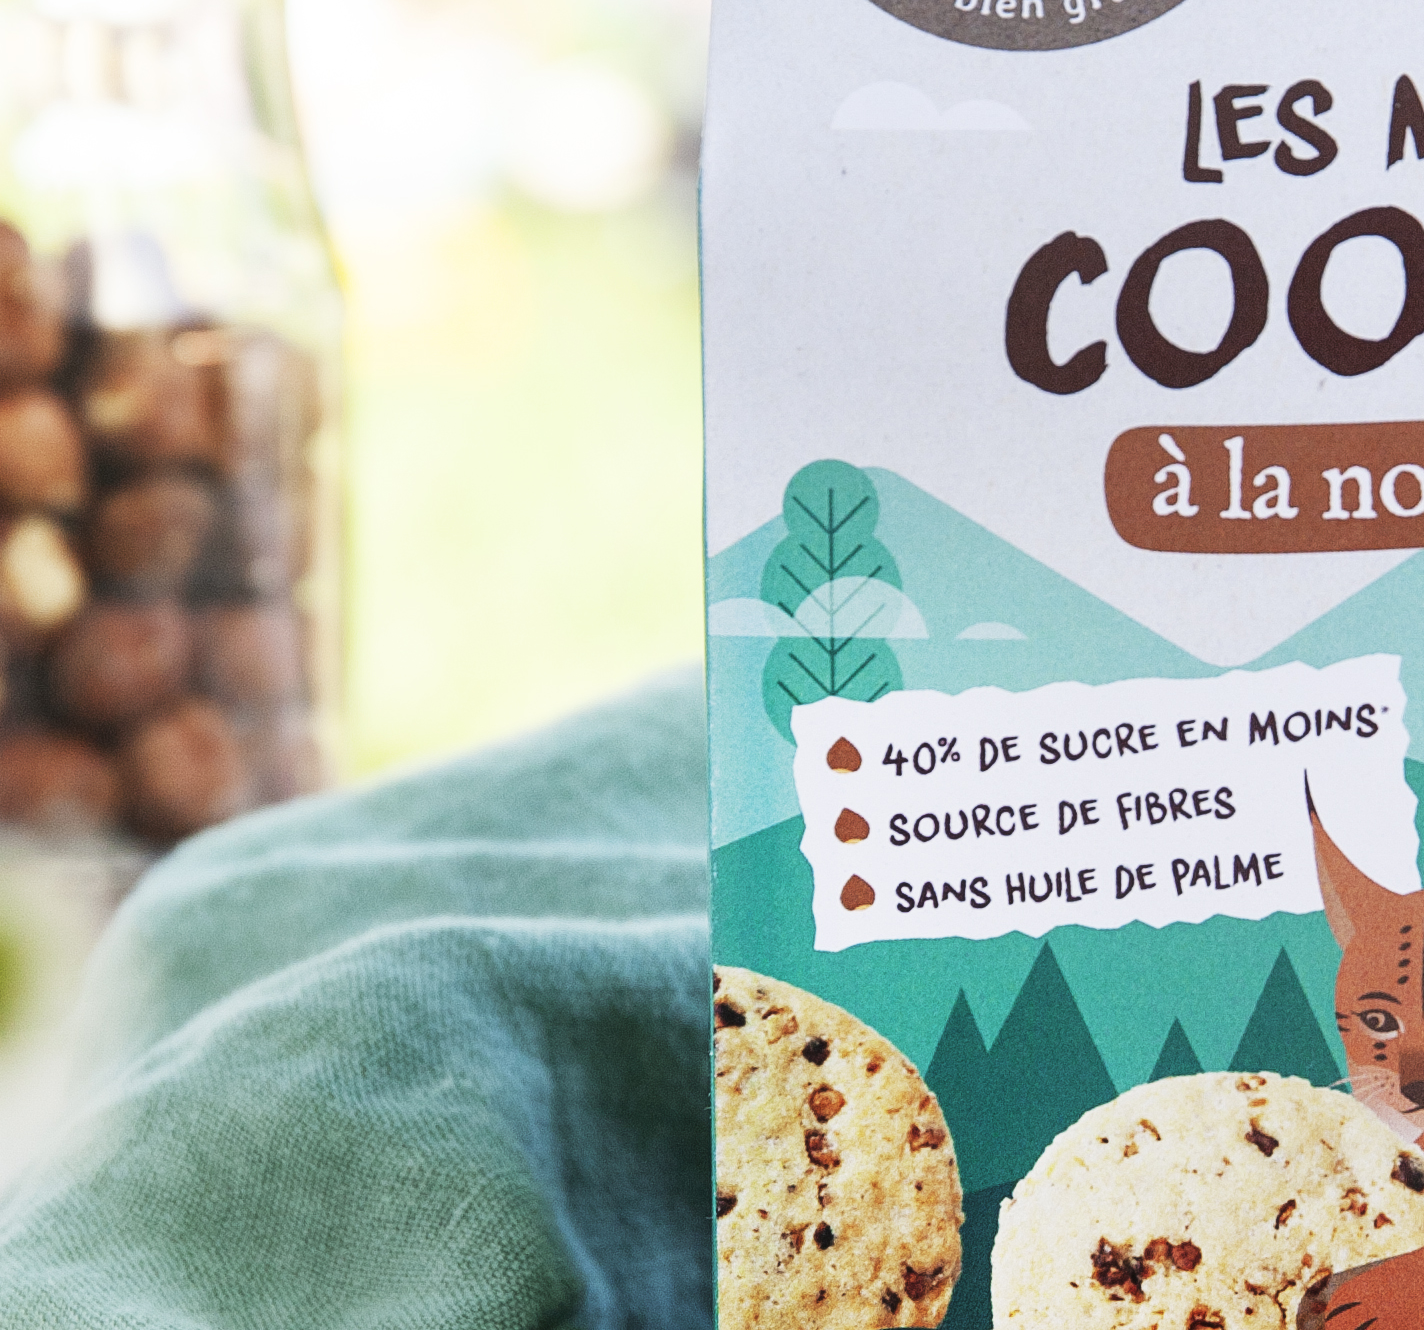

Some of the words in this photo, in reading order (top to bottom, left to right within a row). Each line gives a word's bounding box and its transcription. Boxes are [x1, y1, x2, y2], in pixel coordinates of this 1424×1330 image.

[1183, 79, 1337, 183] LES
[1152, 434, 1198, 517] à
[1219, 436, 1298, 521] la
[882, 737, 961, 777] 40%
[979, 736, 1021, 771] DE
[1039, 723, 1159, 765] SUCRE
[1177, 717, 1231, 747] EN
[888, 803, 1039, 846] SOURCE
[1058, 799, 1100, 834] DE
[1118, 786, 1236, 830] FIBRES
[896, 874, 992, 913] SANS
[1007, 867, 1098, 905] HUILE
[1116, 864, 1156, 899] DE
[1173, 852, 1283, 895] PALME
